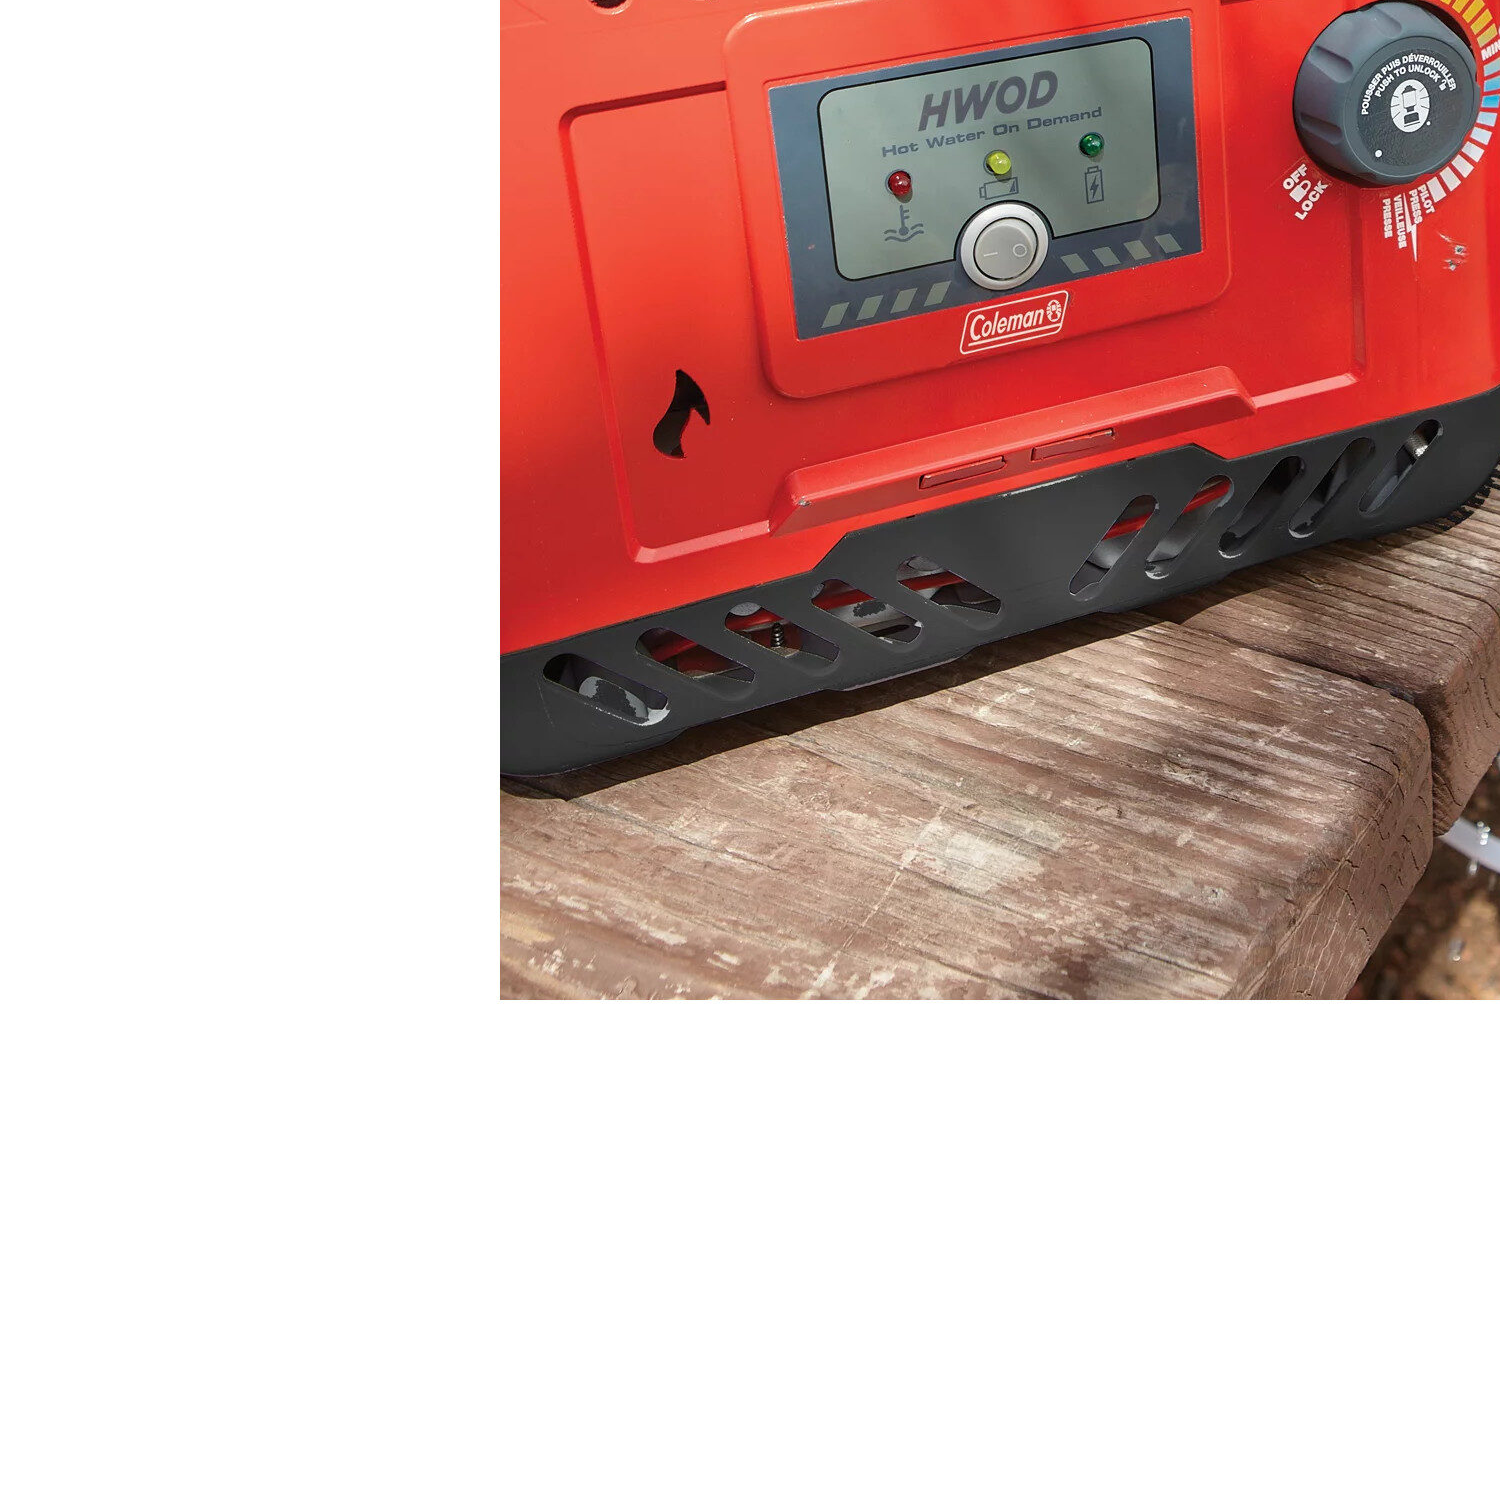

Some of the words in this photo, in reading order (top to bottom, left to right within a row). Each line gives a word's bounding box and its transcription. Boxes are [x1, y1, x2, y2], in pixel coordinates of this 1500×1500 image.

[918, 70, 1059, 132] HWOD
[1361, 72, 1383, 115] POUSSER
[1381, 58, 1401, 76] PUIS
[1402, 52, 1457, 91] DÉVERROUILLER
[1374, 74, 1395, 98] PUSH
[1394, 67, 1407, 78] TO
[1408, 64, 1441, 83] UNLOCK
[882, 142, 919, 158] Hot
[926, 130, 985, 149] Water
[992, 123, 1020, 136] On
[1027, 106, 1102, 130] Demand
[1282, 163, 1308, 190] OFF
[1294, 180, 1329, 221] LOCK
[1382, 198, 1393, 239] PRESSE
[1409, 189, 1423, 225] PRESS
[1417, 183, 1435, 214] PILOT
[1393, 194, 1407, 249] VEILLEUSE
[970, 308, 1044, 341] Coleman
